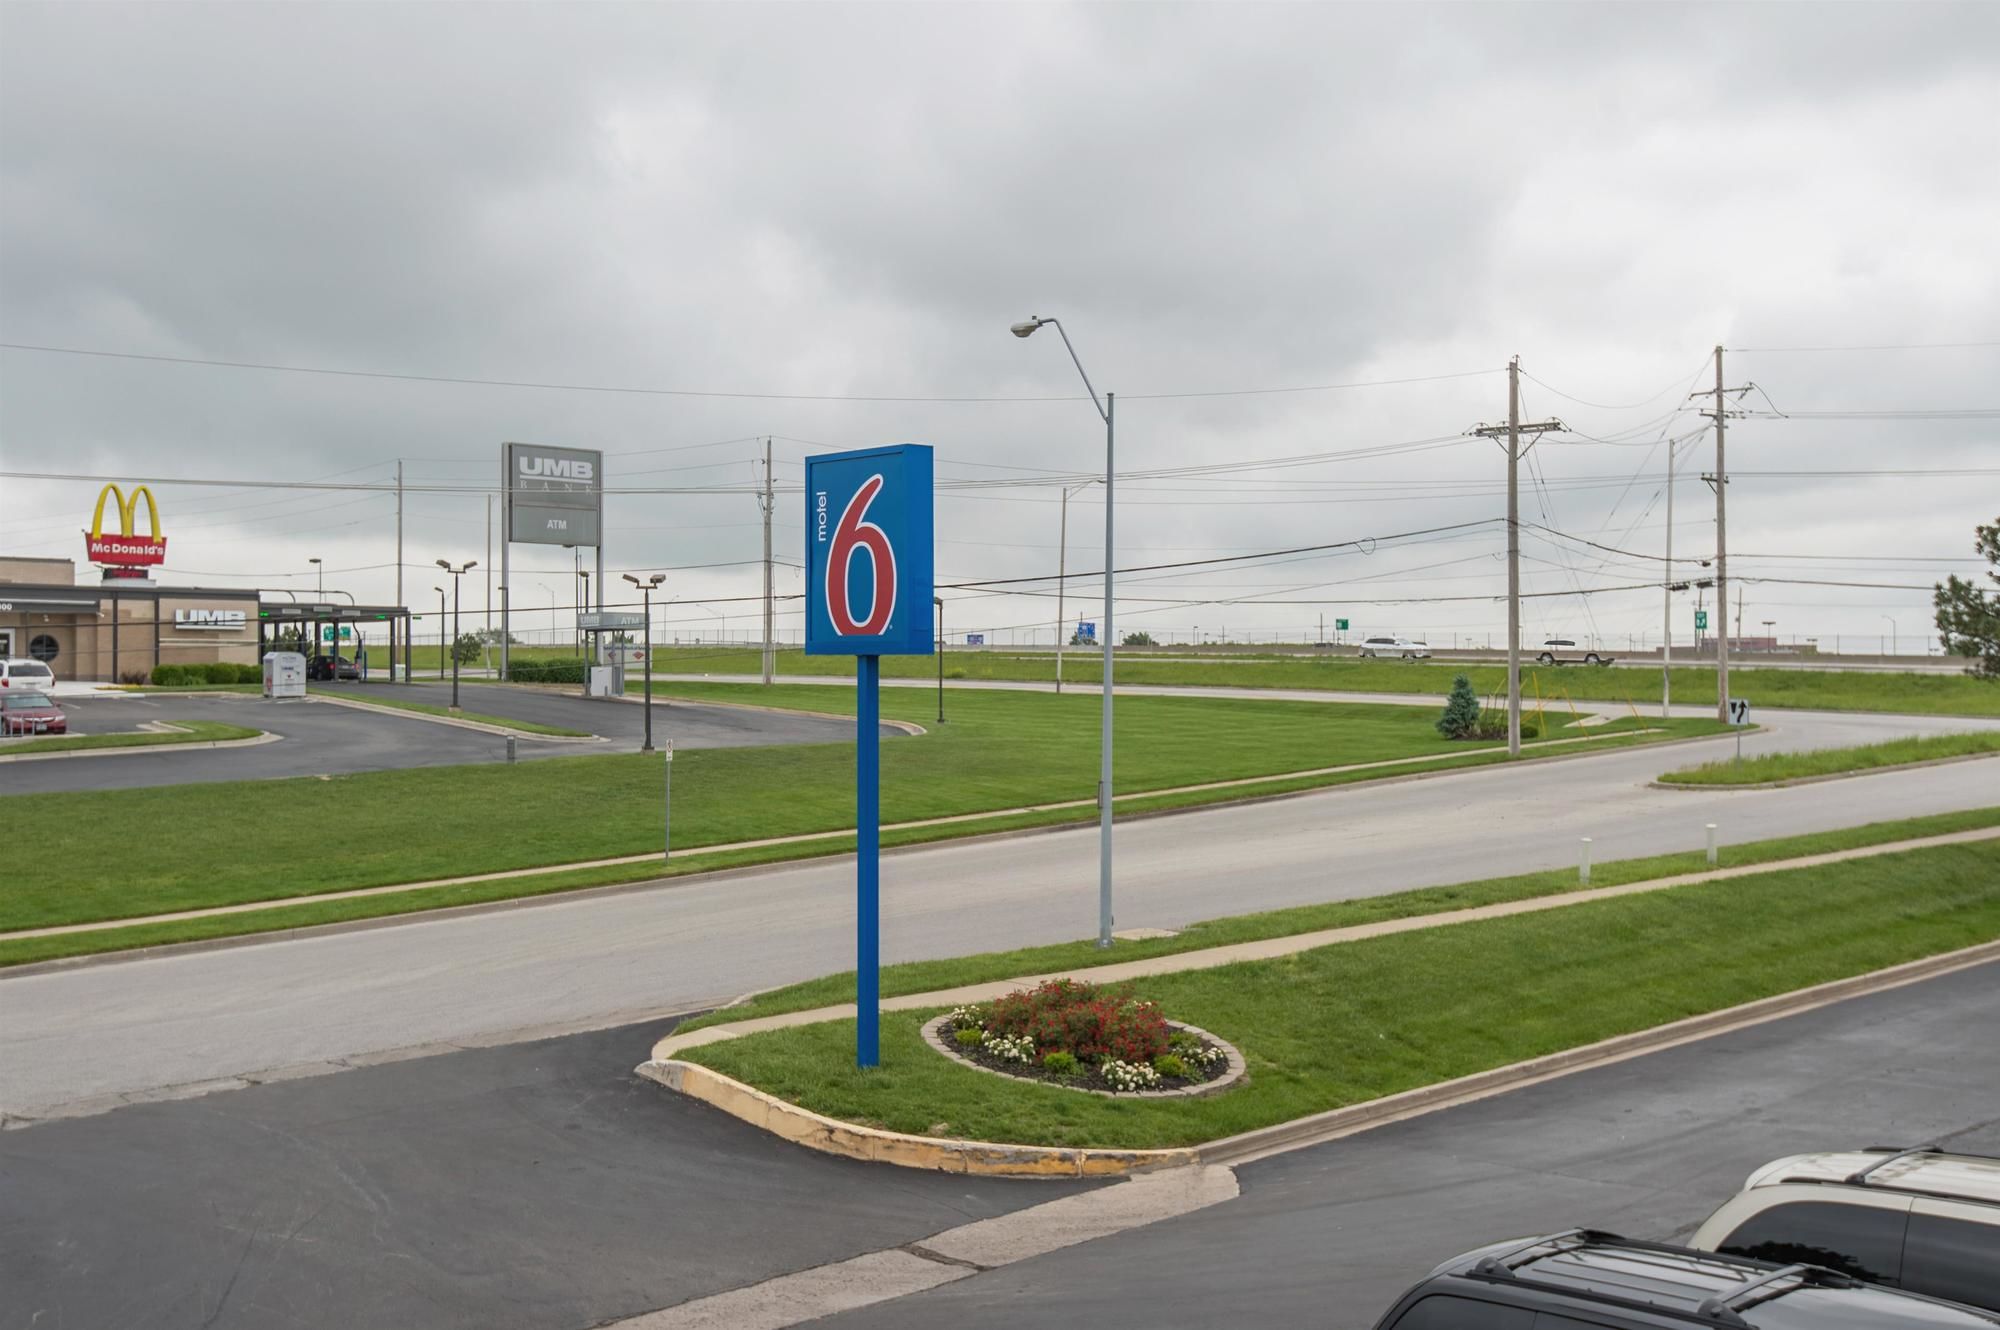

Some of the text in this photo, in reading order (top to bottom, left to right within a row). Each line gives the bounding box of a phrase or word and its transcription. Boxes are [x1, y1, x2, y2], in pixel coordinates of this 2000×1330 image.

[519, 456, 593, 479] UMB
[816, 491, 827, 542] motel
[546, 519, 567, 530] ATM
[91, 543, 164, 556] McDonald's
[825, 473, 897, 636] 6
[175, 608, 247, 626] UMB
[580, 615, 600, 624] UMB
[620, 616, 640, 625] ATM
